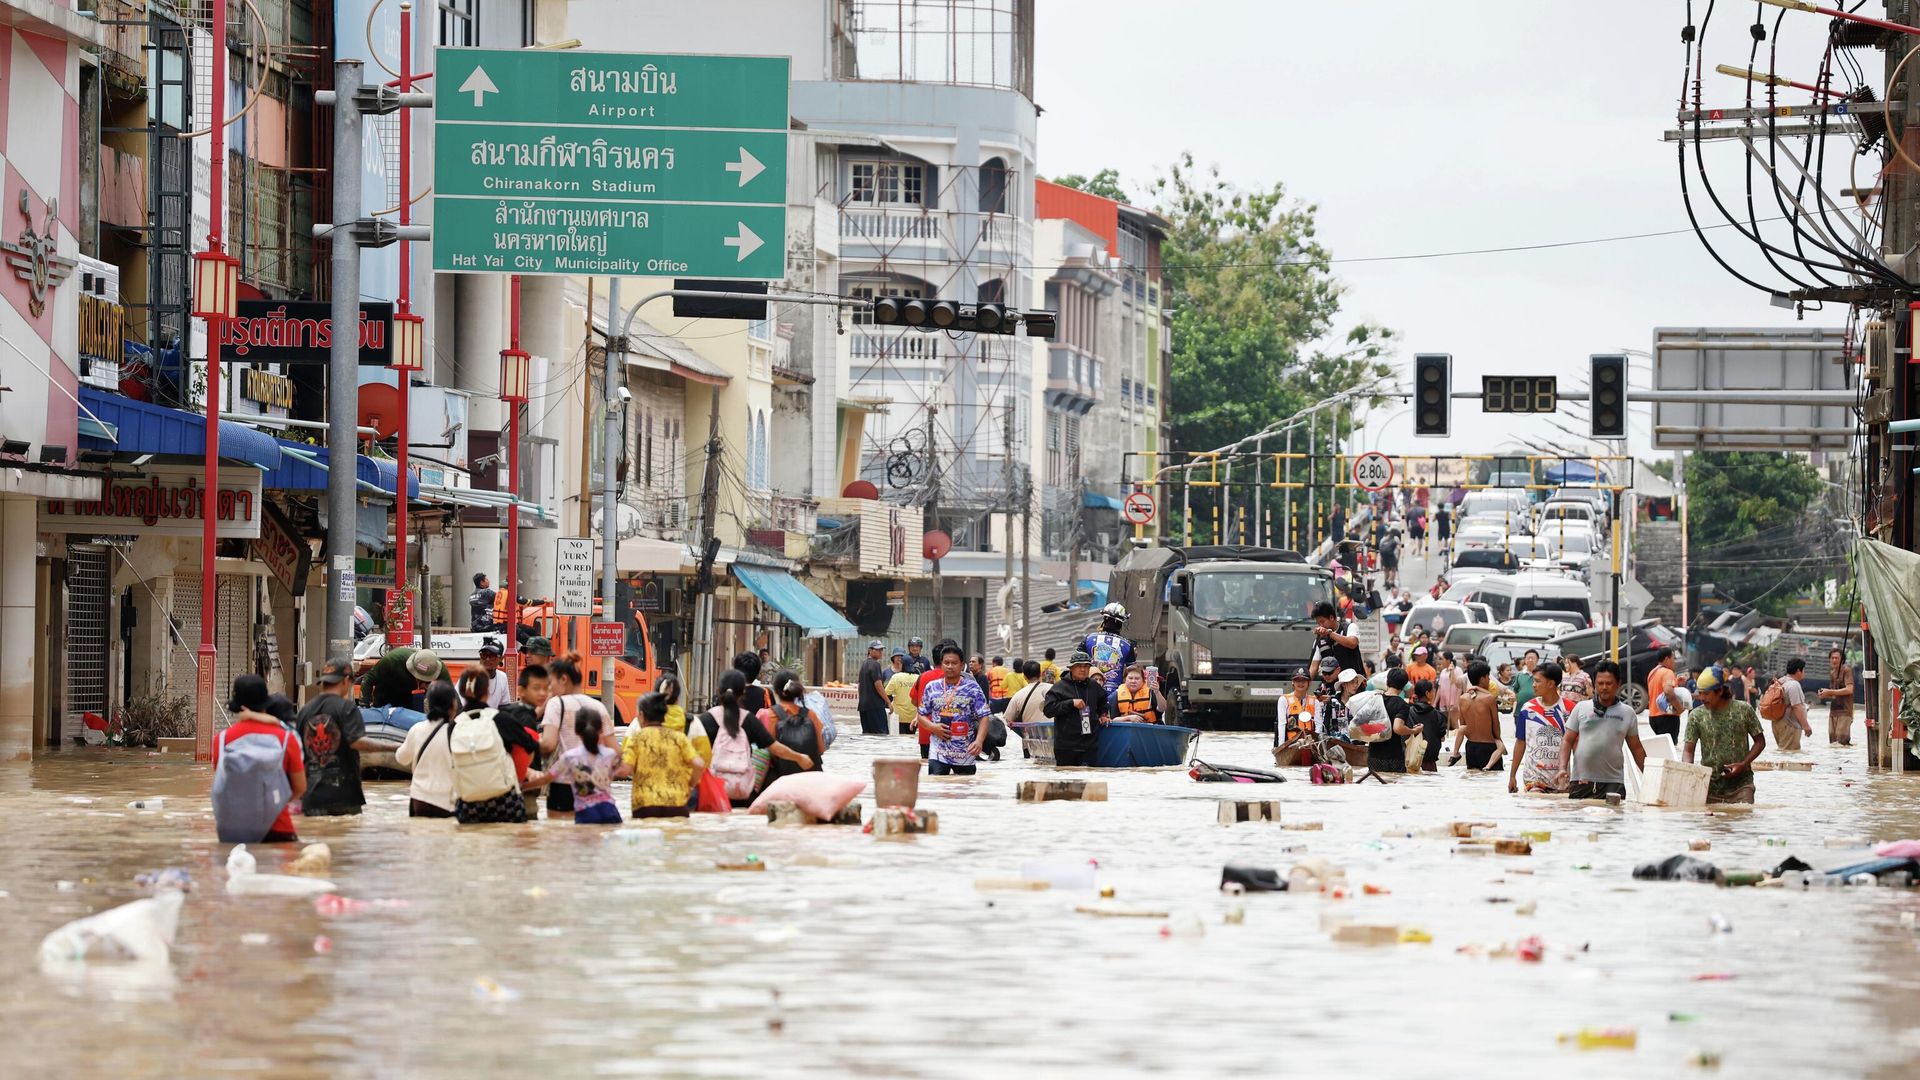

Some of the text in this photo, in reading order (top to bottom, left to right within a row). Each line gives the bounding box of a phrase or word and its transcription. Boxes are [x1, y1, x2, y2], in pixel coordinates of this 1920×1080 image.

[571, 64, 676, 95] สนามบิน
[588, 103, 655, 119] Airport
[1713, 111, 1720, 119] A
[1781, 106, 1788, 116] B
[1837, 106, 1843, 114] C
[471, 136, 675, 170] สนามกีฬาจิรนคร
[483, 176, 656, 193] Chiranakorn Stadium
[495, 200, 649, 229] สำนักงานเทศบาล
[493, 226, 607, 257] นครหาดใหญ่
[452, 253, 689, 274] Hat Yai City Municipality Office
[570, 541, 583, 549] NO
[563, 551, 588, 560] TURN
[574, 564, 592, 572] RED
[430, 642, 452, 650] PRO
